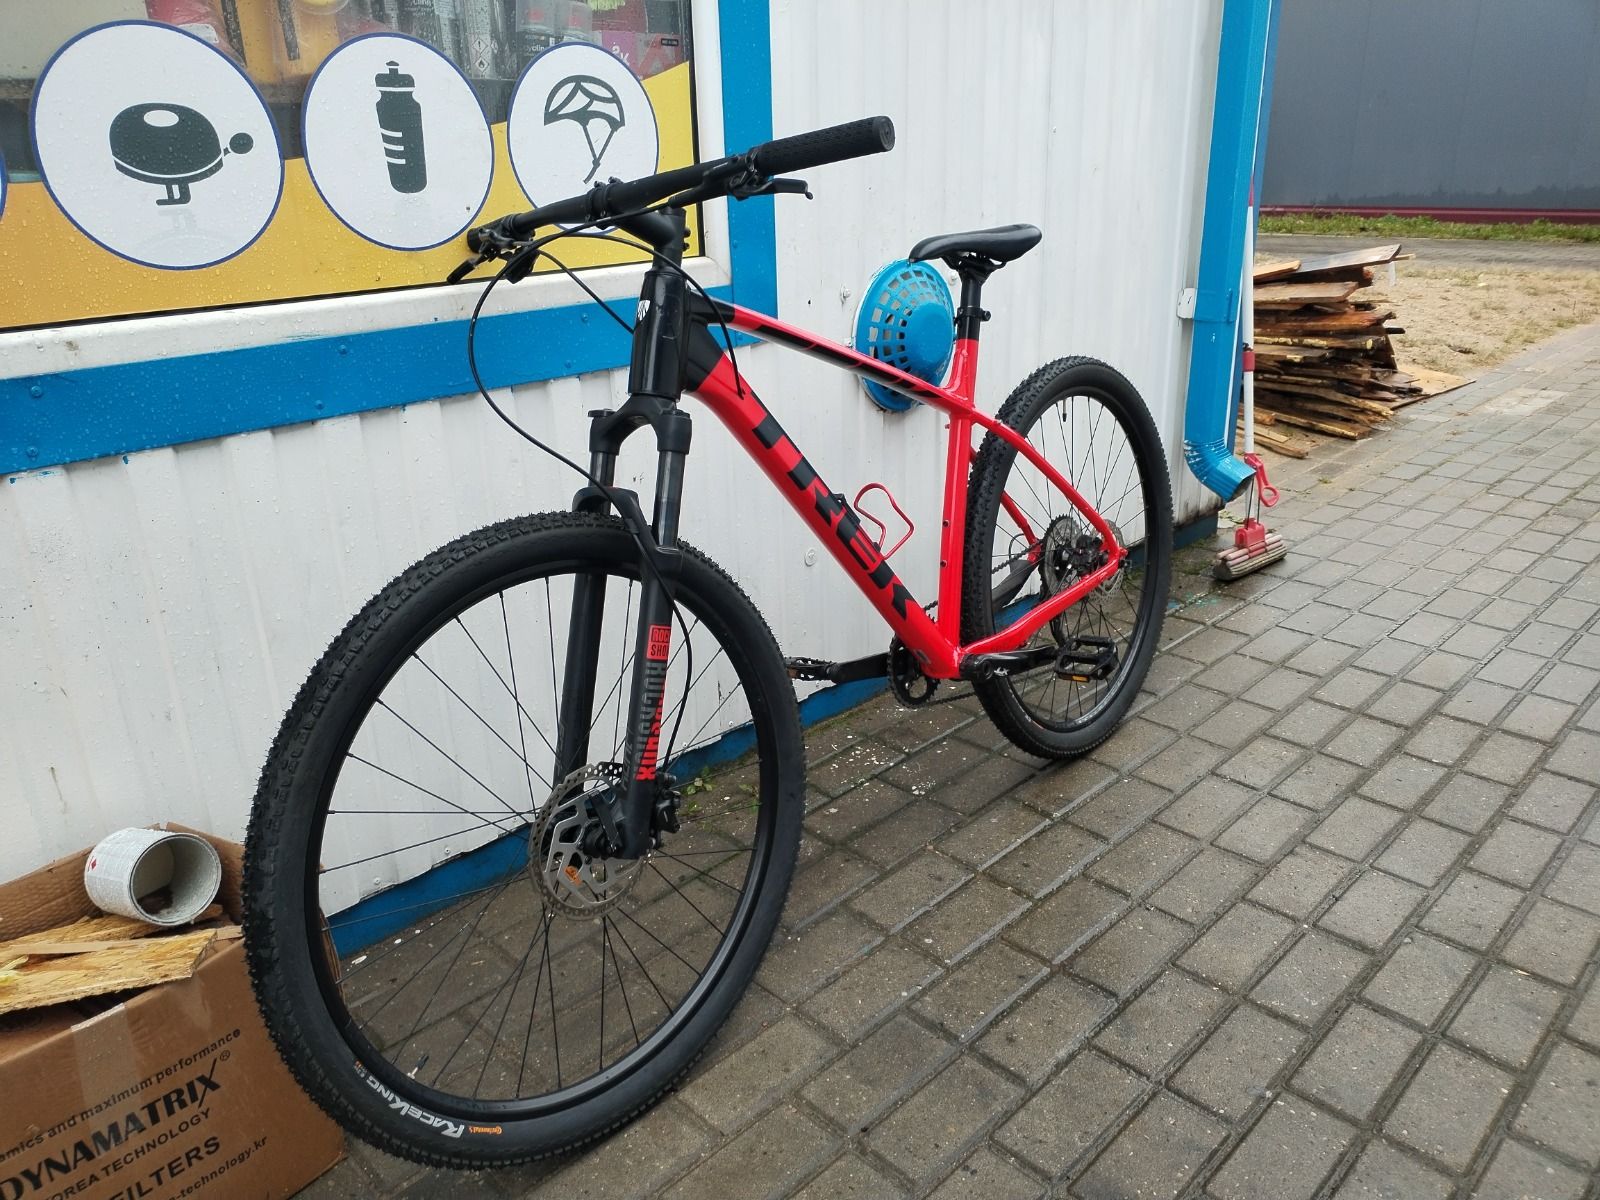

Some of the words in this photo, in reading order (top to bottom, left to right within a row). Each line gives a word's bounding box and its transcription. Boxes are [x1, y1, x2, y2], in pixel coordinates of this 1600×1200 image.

[751, 391, 917, 620] TREK
[650, 643, 668, 657] SHO
[651, 628, 670, 642] ROC
[0, 1058, 221, 1200] DYNAMATRIX
[47, 1114, 77, 1138] and
[80, 1077, 153, 1122] maximum
[155, 1028, 241, 1084] performance
[46, 1174, 101, 1200] OREA
[101, 1107, 210, 1177] TECHNOLOGY
